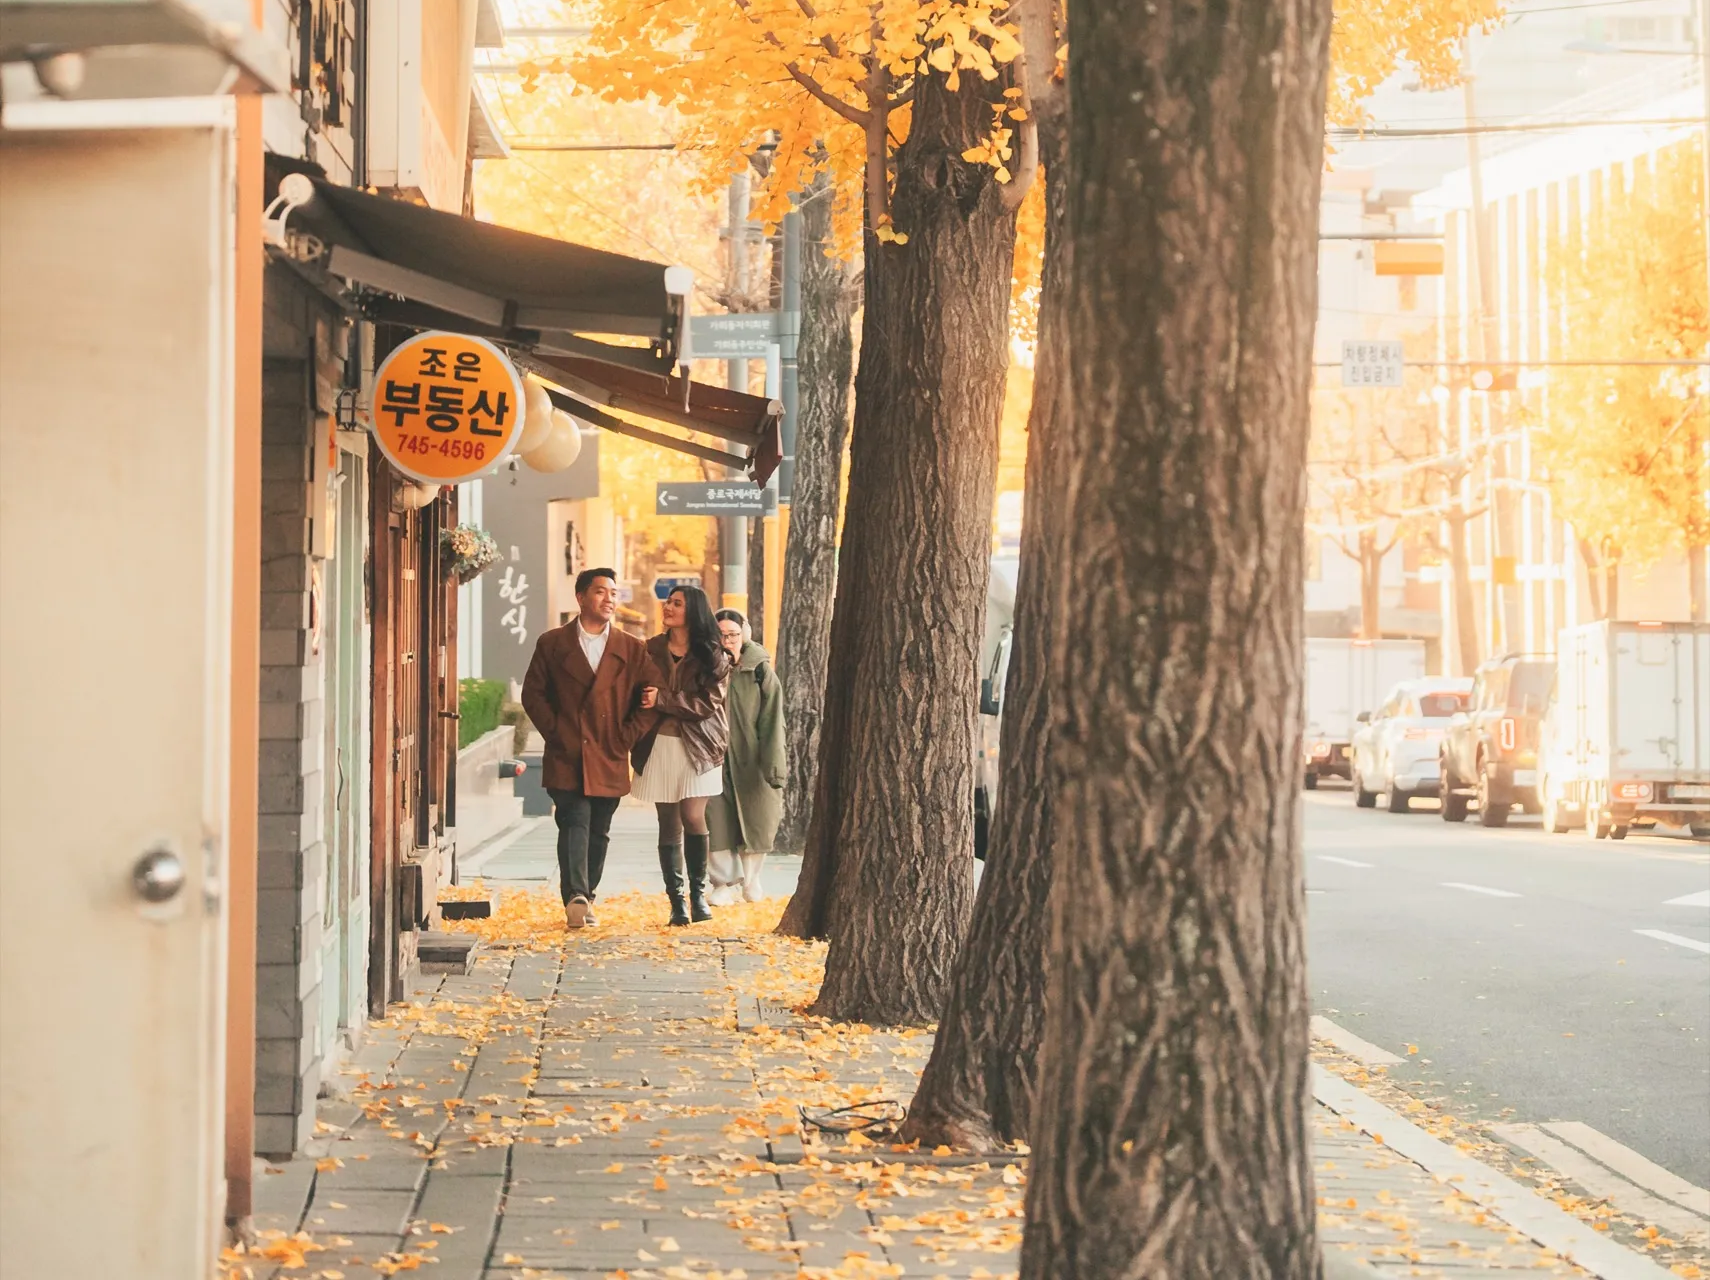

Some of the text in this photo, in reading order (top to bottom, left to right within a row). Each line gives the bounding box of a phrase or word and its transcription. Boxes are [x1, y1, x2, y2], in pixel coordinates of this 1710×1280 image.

[419, 348, 481, 382] 조은
[381, 380, 509, 437] 부동산
[397, 434, 486, 461] 745-4596
[706, 488, 763, 500] 종로국제서당
[498, 566, 530, 645] 한식
